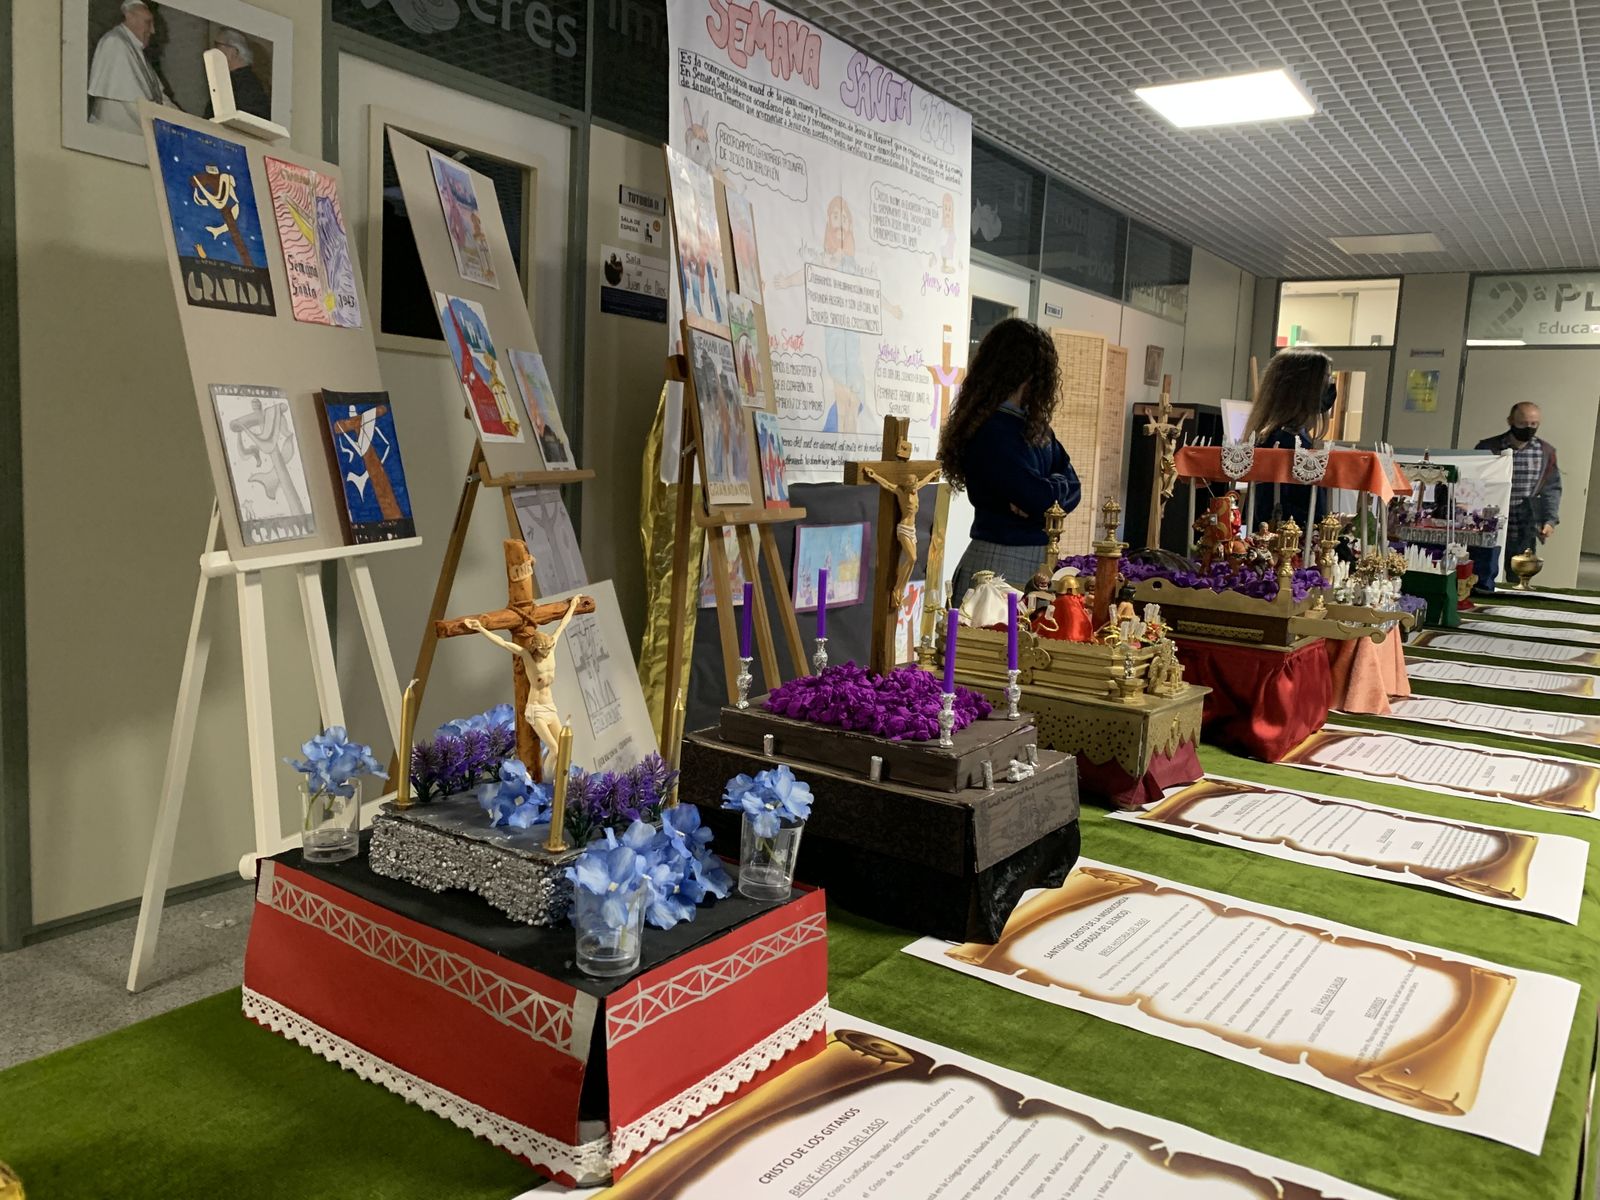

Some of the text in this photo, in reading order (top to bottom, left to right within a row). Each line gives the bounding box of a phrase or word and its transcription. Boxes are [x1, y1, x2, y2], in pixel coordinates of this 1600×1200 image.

[681, 52, 691, 64] Es
[694, 53, 701, 67] la
[706, 0, 822, 89] SEMANA
[840, 51, 914, 125] SANTA
[680, 64, 690, 76] En
[621, 216, 633, 224] SALA
[621, 223, 638, 233] ESPERA
[626, 253, 641, 265] Sala
[626, 273, 666, 297] Juan de Dios
[759, 1108, 860, 1184] CRISTO DE LOS GITANOS
[789, 1119, 888, 1196] BREVE HISTORIA DEL PASO
[827, 1184, 845, 1197] Cristo
[870, 1143, 892, 1160] llamado
[910, 1113, 926, 1124] Cristo
[869, 1178, 886, 1191] Cristo
